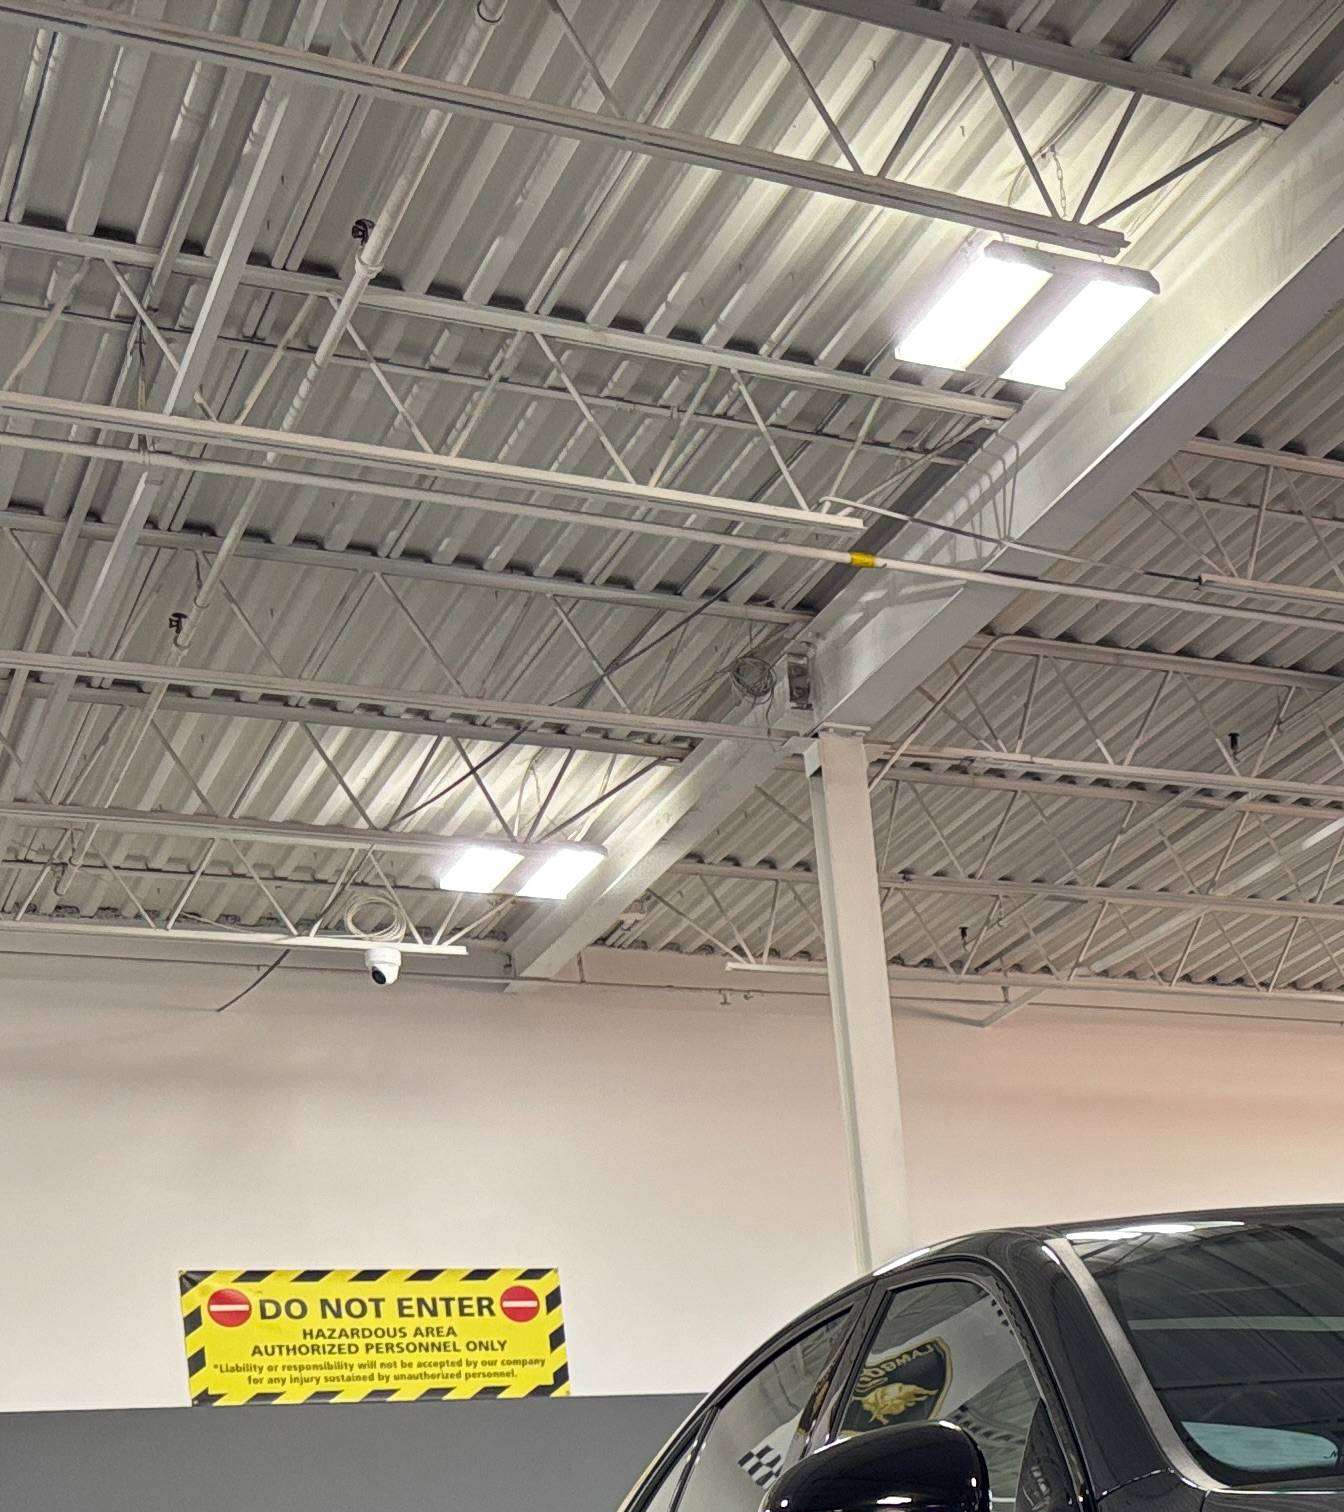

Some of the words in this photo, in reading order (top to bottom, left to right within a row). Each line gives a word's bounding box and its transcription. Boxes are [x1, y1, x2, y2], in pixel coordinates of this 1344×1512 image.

[259, 1297, 308, 1320] DO
[320, 1297, 385, 1319] NOT
[397, 1296, 496, 1318] ENTER
[302, 1326, 408, 1340] HAZARDOUS
[413, 1325, 458, 1339] AREA
[251, 1341, 360, 1357] AUTHORIZED
[365, 1339, 461, 1354] PERSONNEL
[466, 1339, 508, 1353] ONLY
[267, 1364, 278, 1373] or
[281, 1361, 355, 1374] responsibility
[357, 1360, 377, 1370] will
[380, 1361, 398, 1370] not
[400, 1360, 413, 1369] be
[416, 1358, 463, 1370] accepted
[465, 1358, 478, 1369] by
[481, 1359, 498, 1367] our
[501, 1357, 546, 1369] company
[247, 1375, 264, 1385] for
[267, 1376, 287, 1387] any
[289, 1374, 320, 1387] injury
[324, 1373, 375, 1384] sustained
[377, 1372, 391, 1383] by
[393, 1370, 462, 1382] unauthorized
[464, 1369, 517, 1381] personnel.
